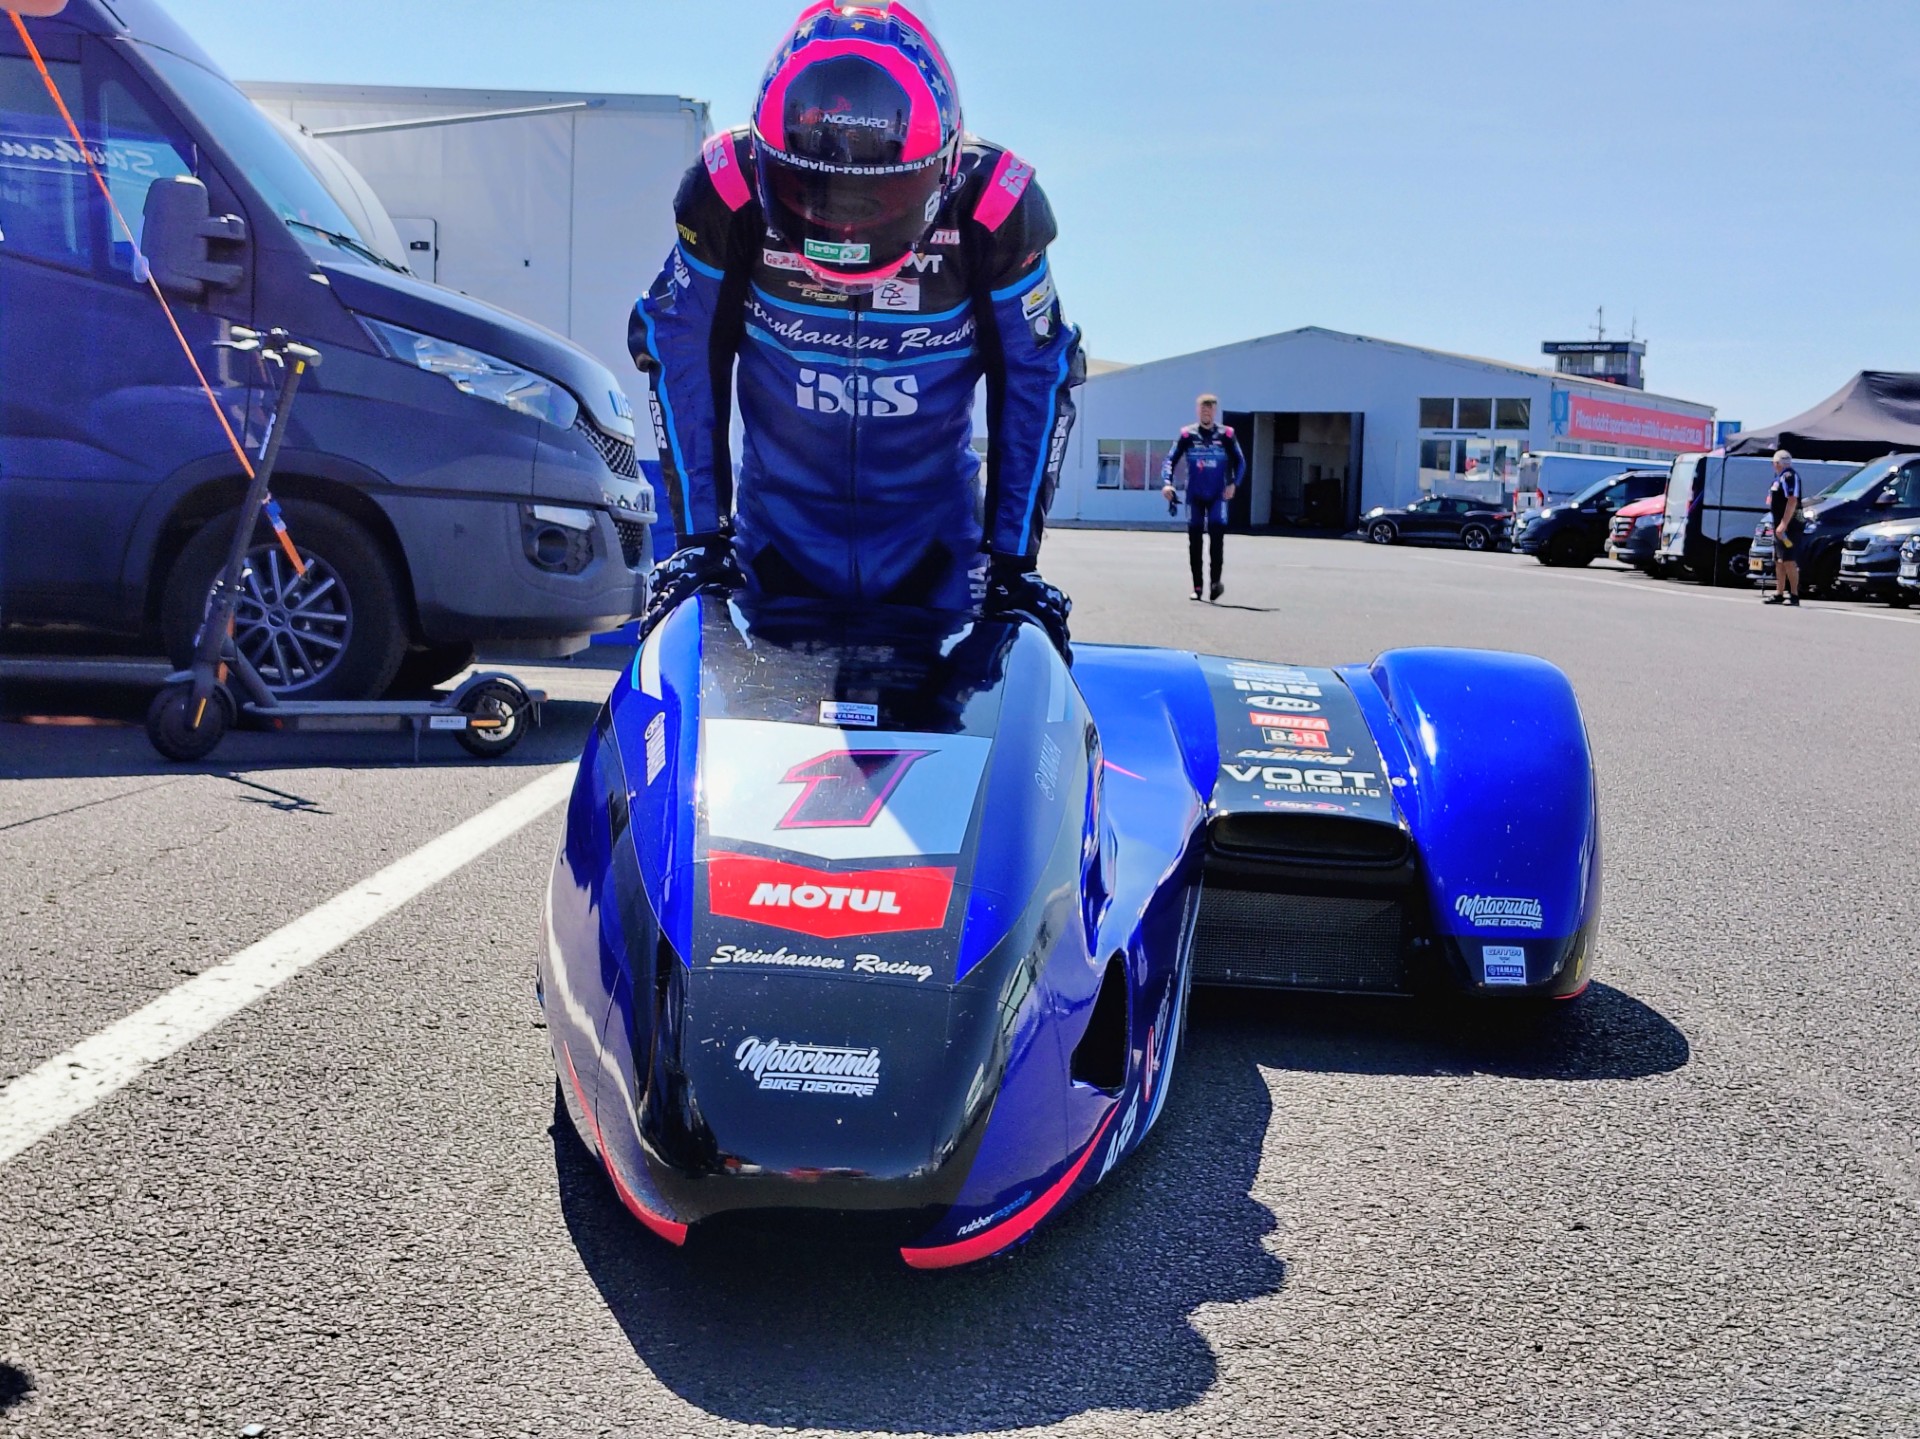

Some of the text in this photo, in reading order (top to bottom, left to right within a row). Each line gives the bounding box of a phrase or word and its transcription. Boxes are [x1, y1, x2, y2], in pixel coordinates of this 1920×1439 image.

[822, 113, 889, 129] NOGARO
[762, 142, 937, 176] www.kevin-rousseau.fr
[837, 713, 872, 721] YAMAHA
[1270, 730, 1320, 743] B&R
[1222, 764, 1376, 788] VOGT
[774, 749, 943, 831] 1
[1264, 782, 1381, 798] engineering
[749, 882, 901, 914] MOTUL
[1474, 919, 1542, 930] BIKE DEKORE
[710, 945, 934, 983] Steinhausen Racing
[758, 1077, 877, 1098] BIKE DEKORE
